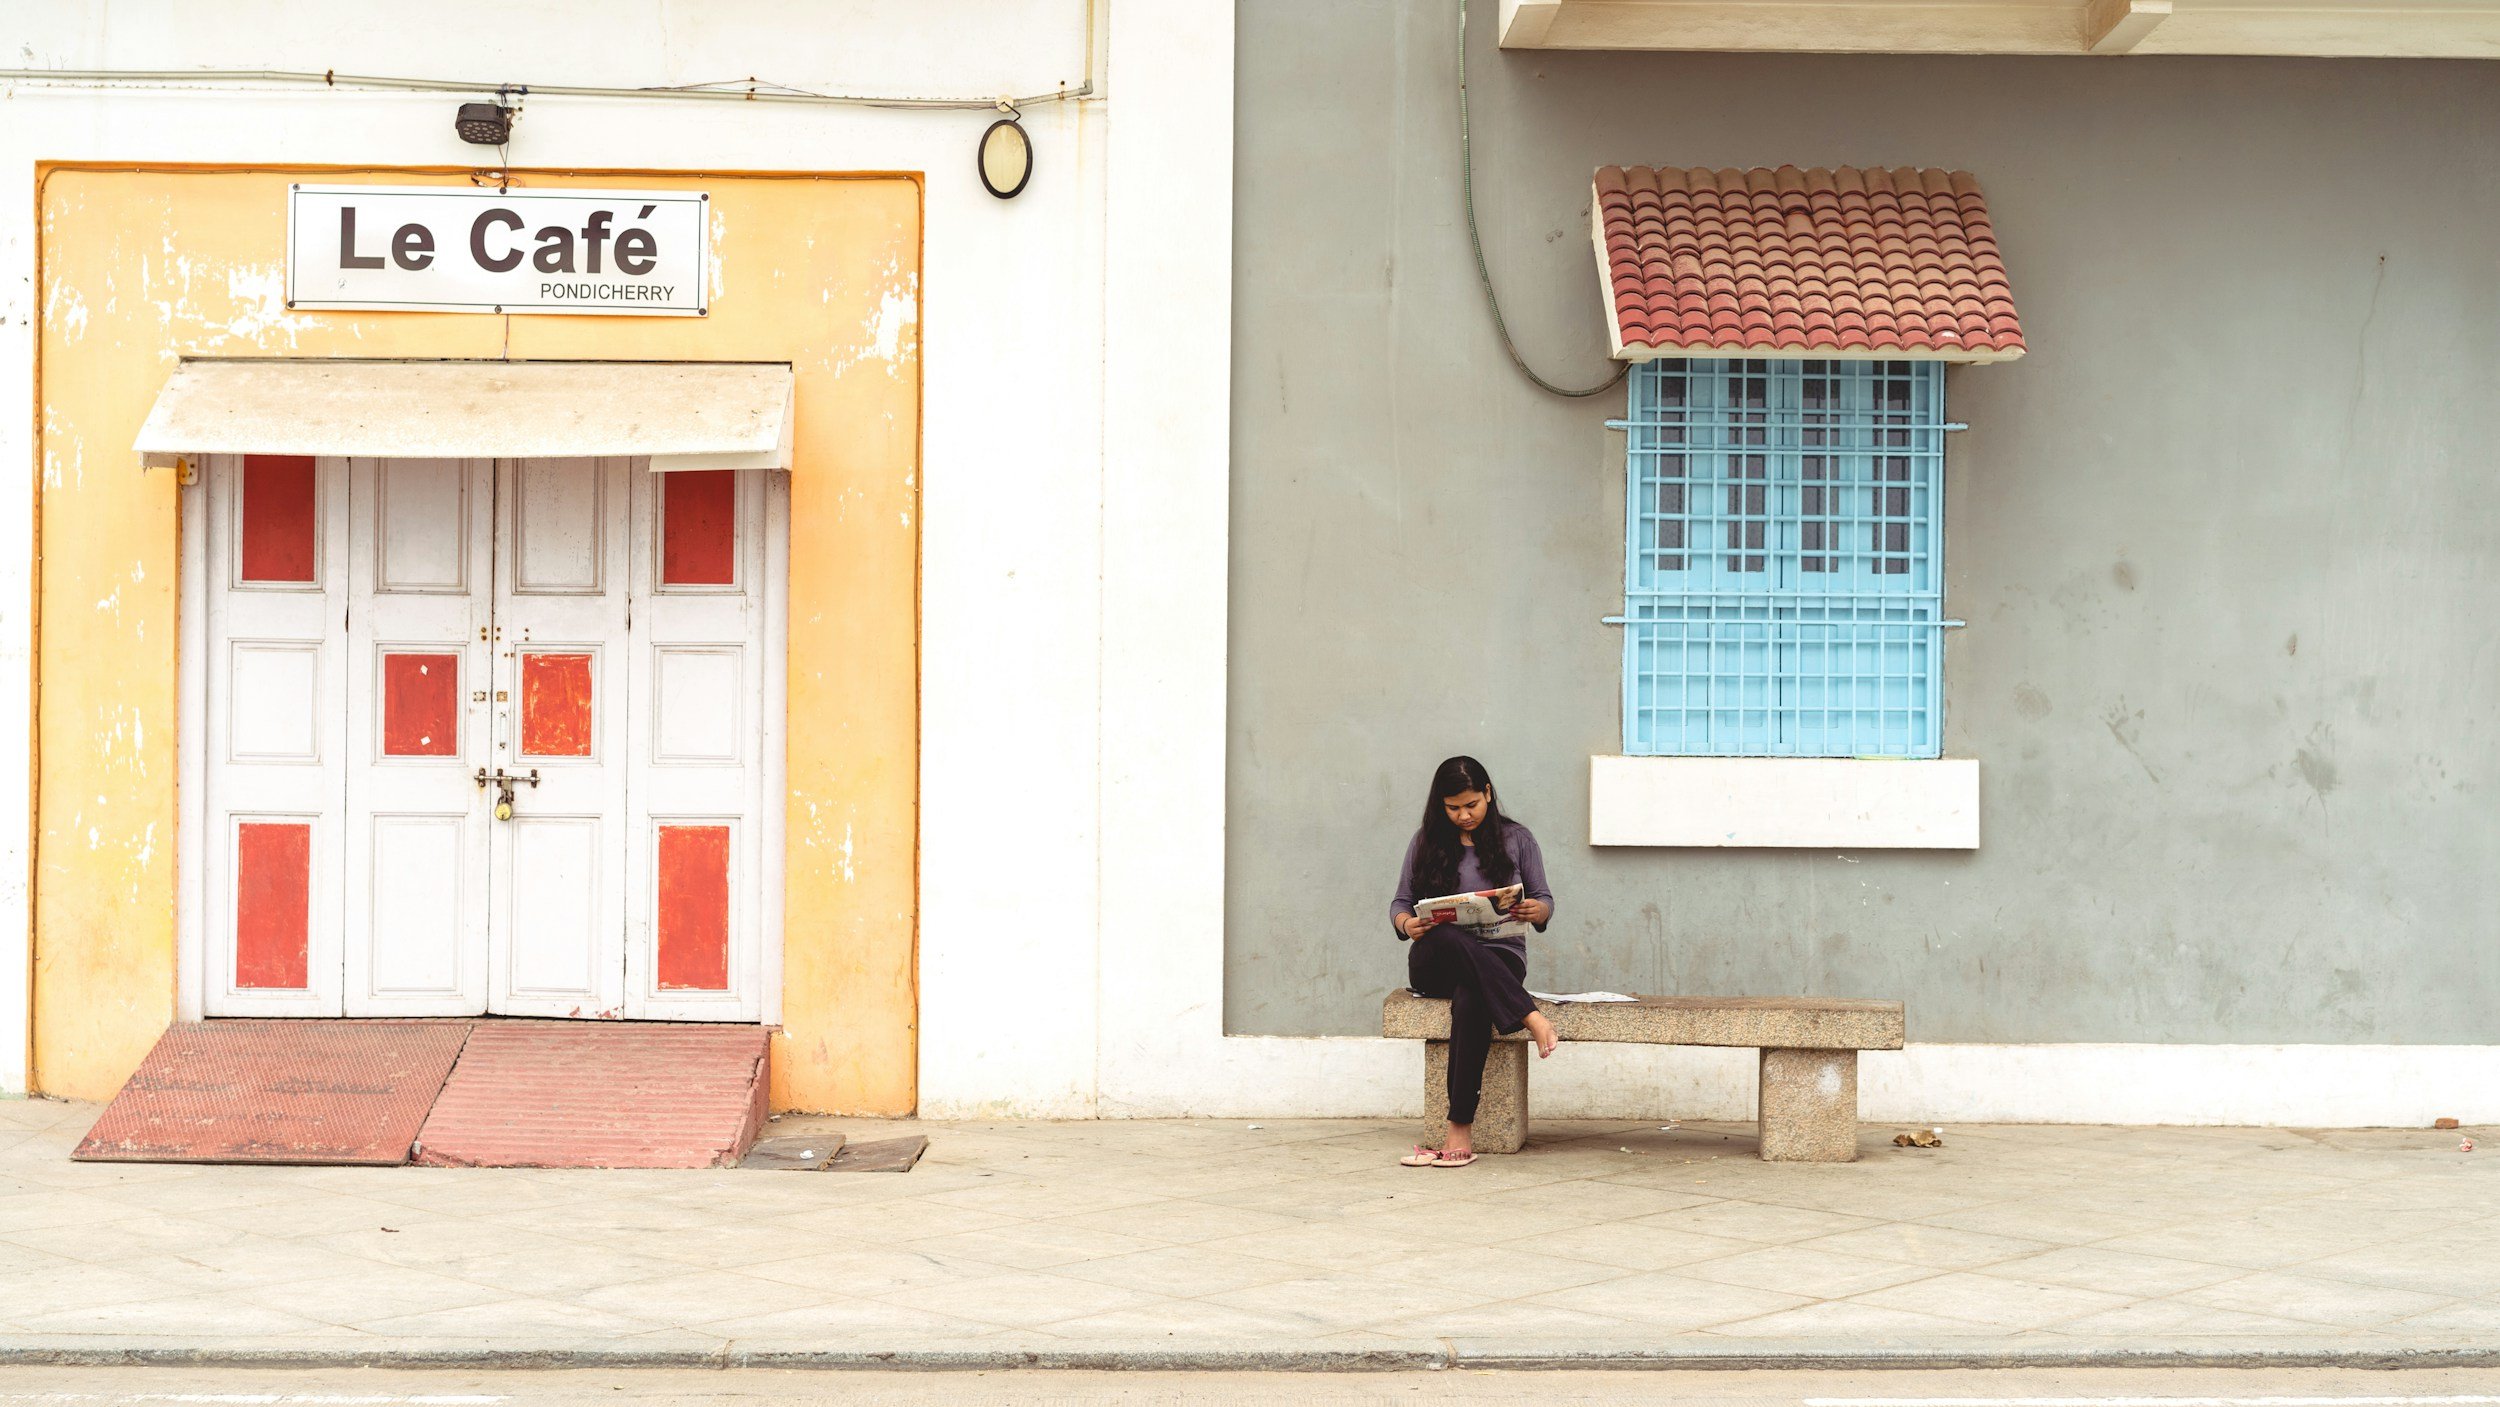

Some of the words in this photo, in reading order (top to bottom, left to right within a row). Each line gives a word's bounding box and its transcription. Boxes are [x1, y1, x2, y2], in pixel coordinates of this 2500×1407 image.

[340, 206, 435, 271] Le
[470, 205, 657, 276] Café
[541, 283, 675, 301] PONDICHERRY
